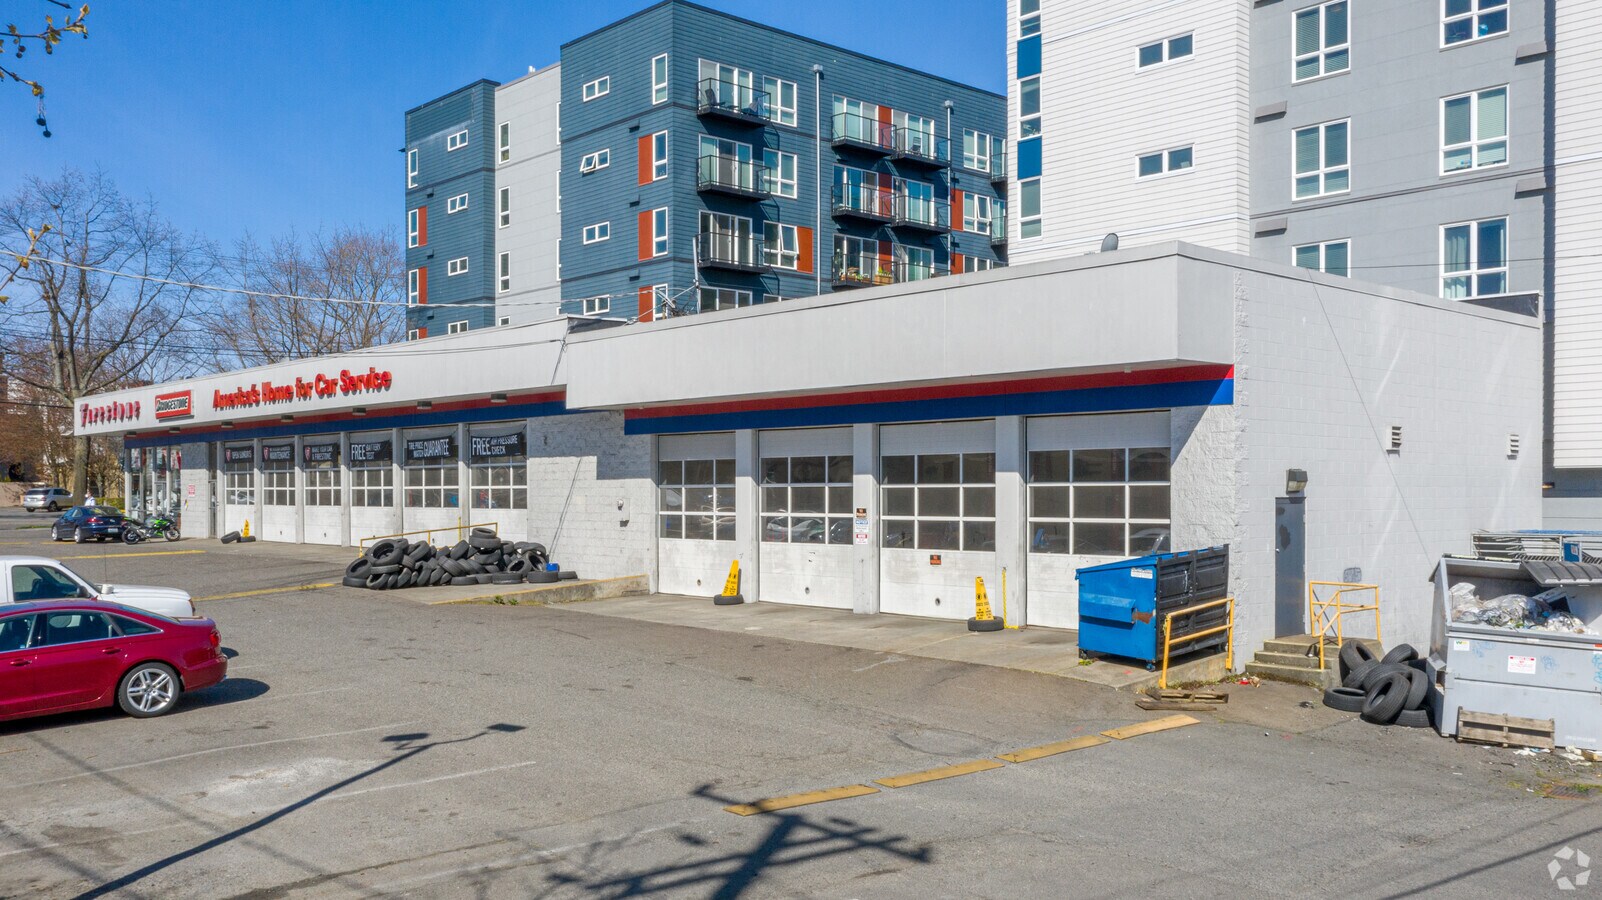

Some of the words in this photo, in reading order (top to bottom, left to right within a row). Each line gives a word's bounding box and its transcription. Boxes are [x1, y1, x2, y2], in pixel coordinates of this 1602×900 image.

[213, 384, 260, 408] America's
[262, 381, 294, 402] Home
[296, 377, 313, 398] for
[315, 373, 338, 396] Car
[340, 367, 392, 393] Service
[156, 396, 189, 413] BRIDGESTONE
[80, 401, 141, 428] Firestone
[351, 444, 366, 460] FREE
[424, 438, 449, 457] GUARANTEE
[472, 438, 491, 456] FREE
[498, 435, 518, 445] PRESSURE
[491, 445, 506, 455] CHECK
